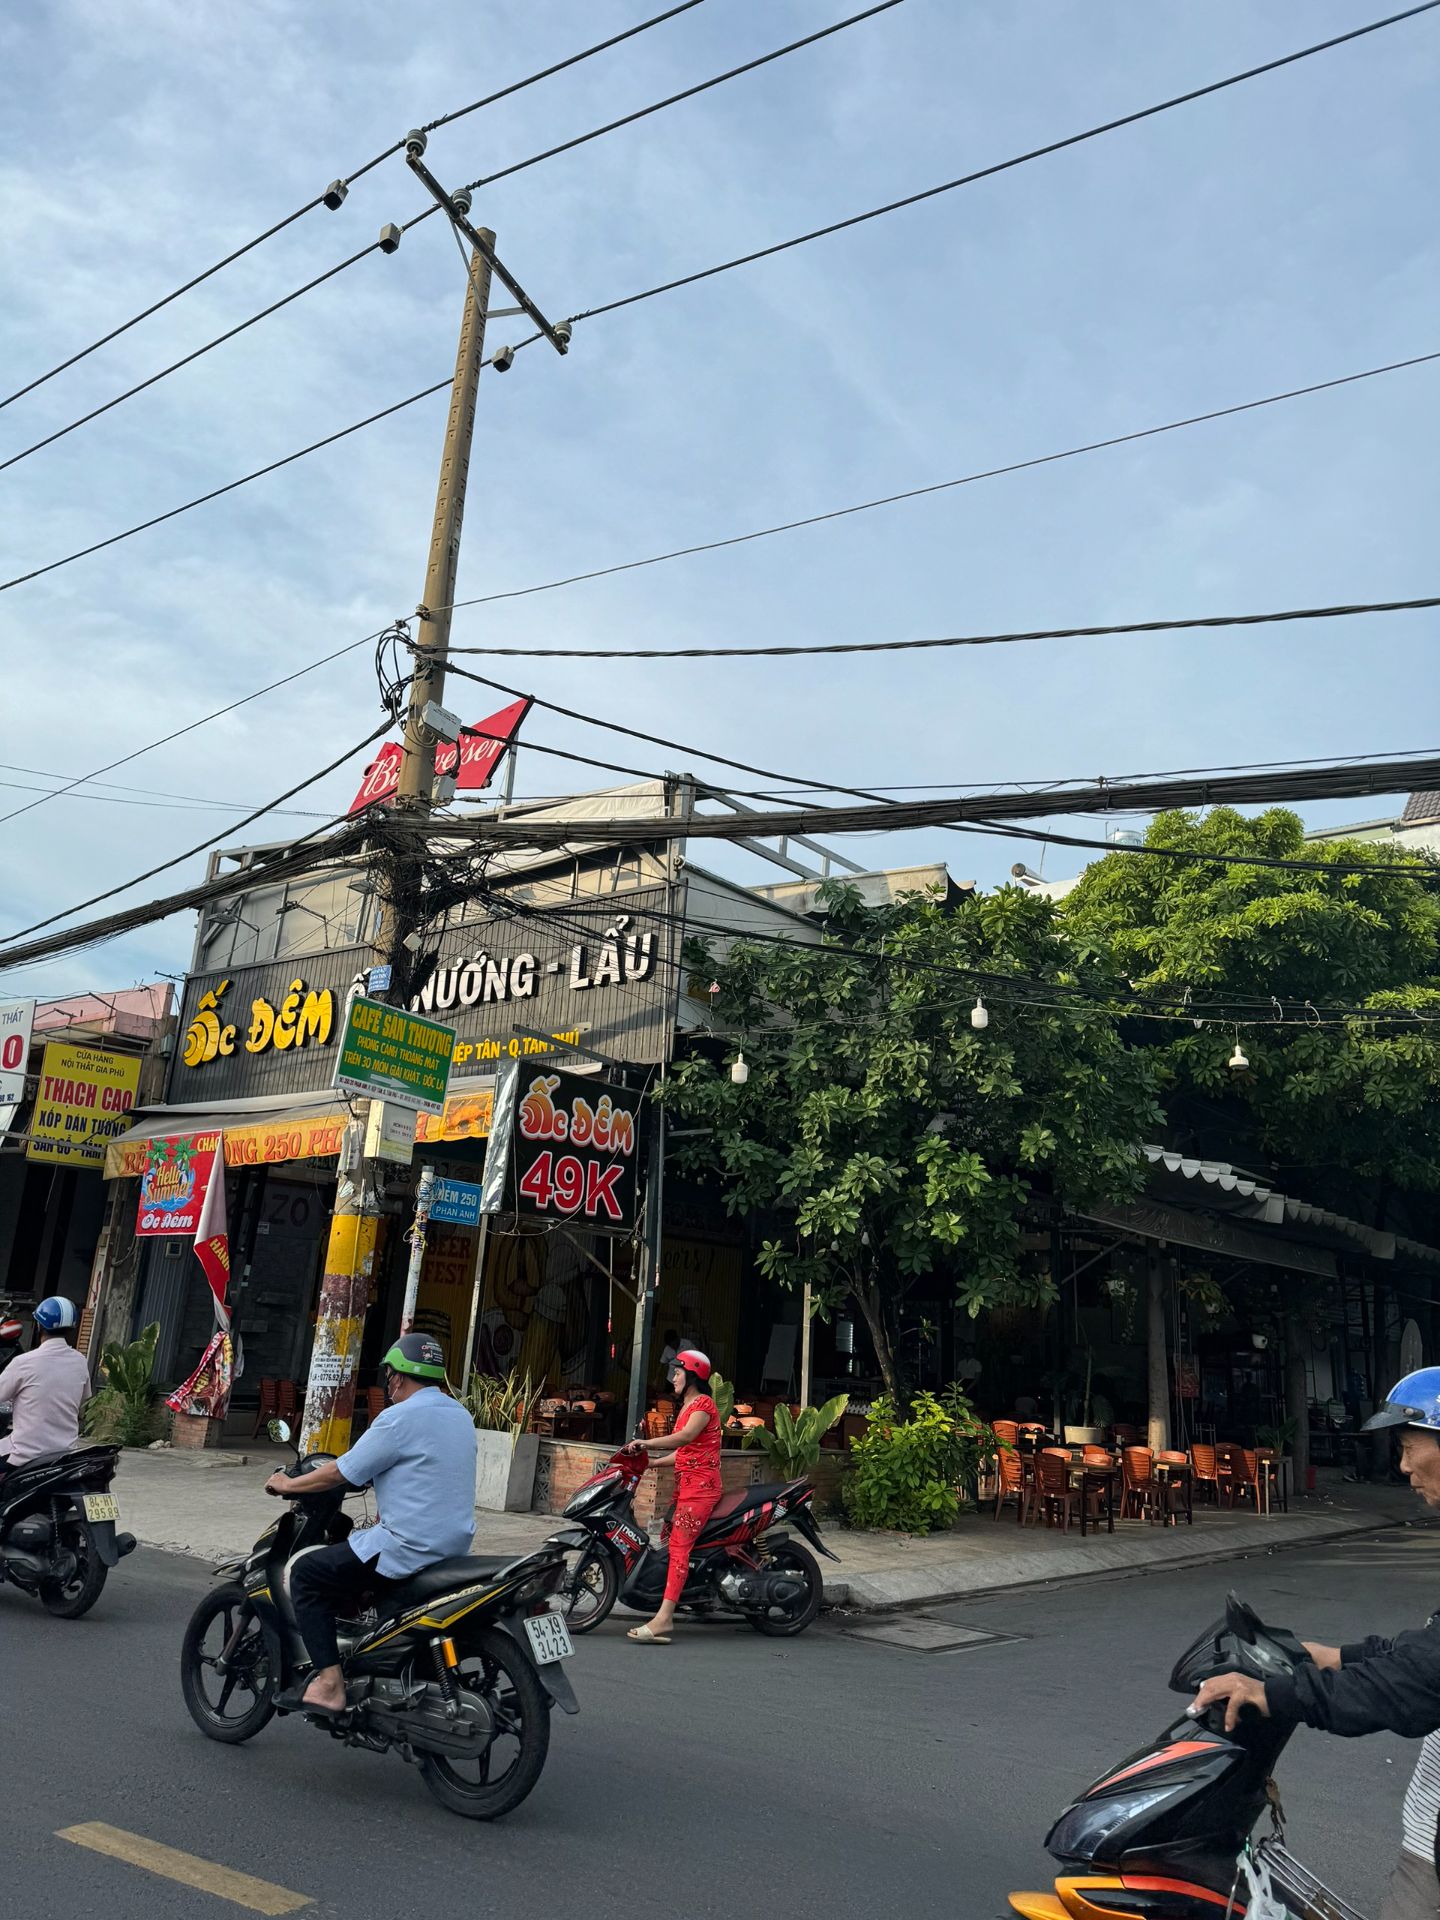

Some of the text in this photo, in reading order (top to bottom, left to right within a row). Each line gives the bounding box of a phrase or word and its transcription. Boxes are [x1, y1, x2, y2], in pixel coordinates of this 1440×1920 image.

[412, 951, 535, 1012] NƯỚNG
[570, 915, 652, 990] LẨU
[2, 1008, 24, 1026] THẤT
[246, 978, 334, 1053] ĐÊM
[352, 1003, 453, 1058] CAFÉ SÂN THƯỢNG
[93, 1052, 114, 1065] HÀNG
[357, 1035, 380, 1053] PHONG
[400, 1048, 424, 1067] THOÁNG
[424, 1056, 440, 1071] MÁT
[475, 1038, 500, 1060] TÂN
[61, 1059, 74, 1070] NỘI
[76, 1060, 93, 1072] THẤT
[96, 1066, 109, 1075] GIA
[344, 1050, 361, 1066] TRÊN
[362, 1056, 372, 1068] 30
[372, 1059, 389, 1073] MÓN
[44, 1076, 133, 1113] THẠCH CAO
[38, 1106, 62, 1130] XỐP
[65, 1112, 87, 1133] DÁN
[570, 1094, 635, 1156] ĐÊM
[263, 1132, 302, 1162] 250
[307, 1126, 342, 1157] PH
[156, 1165, 182, 1186] Hello
[520, 1150, 625, 1220] 49K
[146, 1182, 192, 1203] Summer
[460, 1193, 478, 1207] 250
[435, 1206, 476, 1220] PHAN ANH
[423, 1262, 469, 1285] FEST
[531, 1616, 562, 1639] 54-X9
[538, 1636, 569, 1660] 3423
